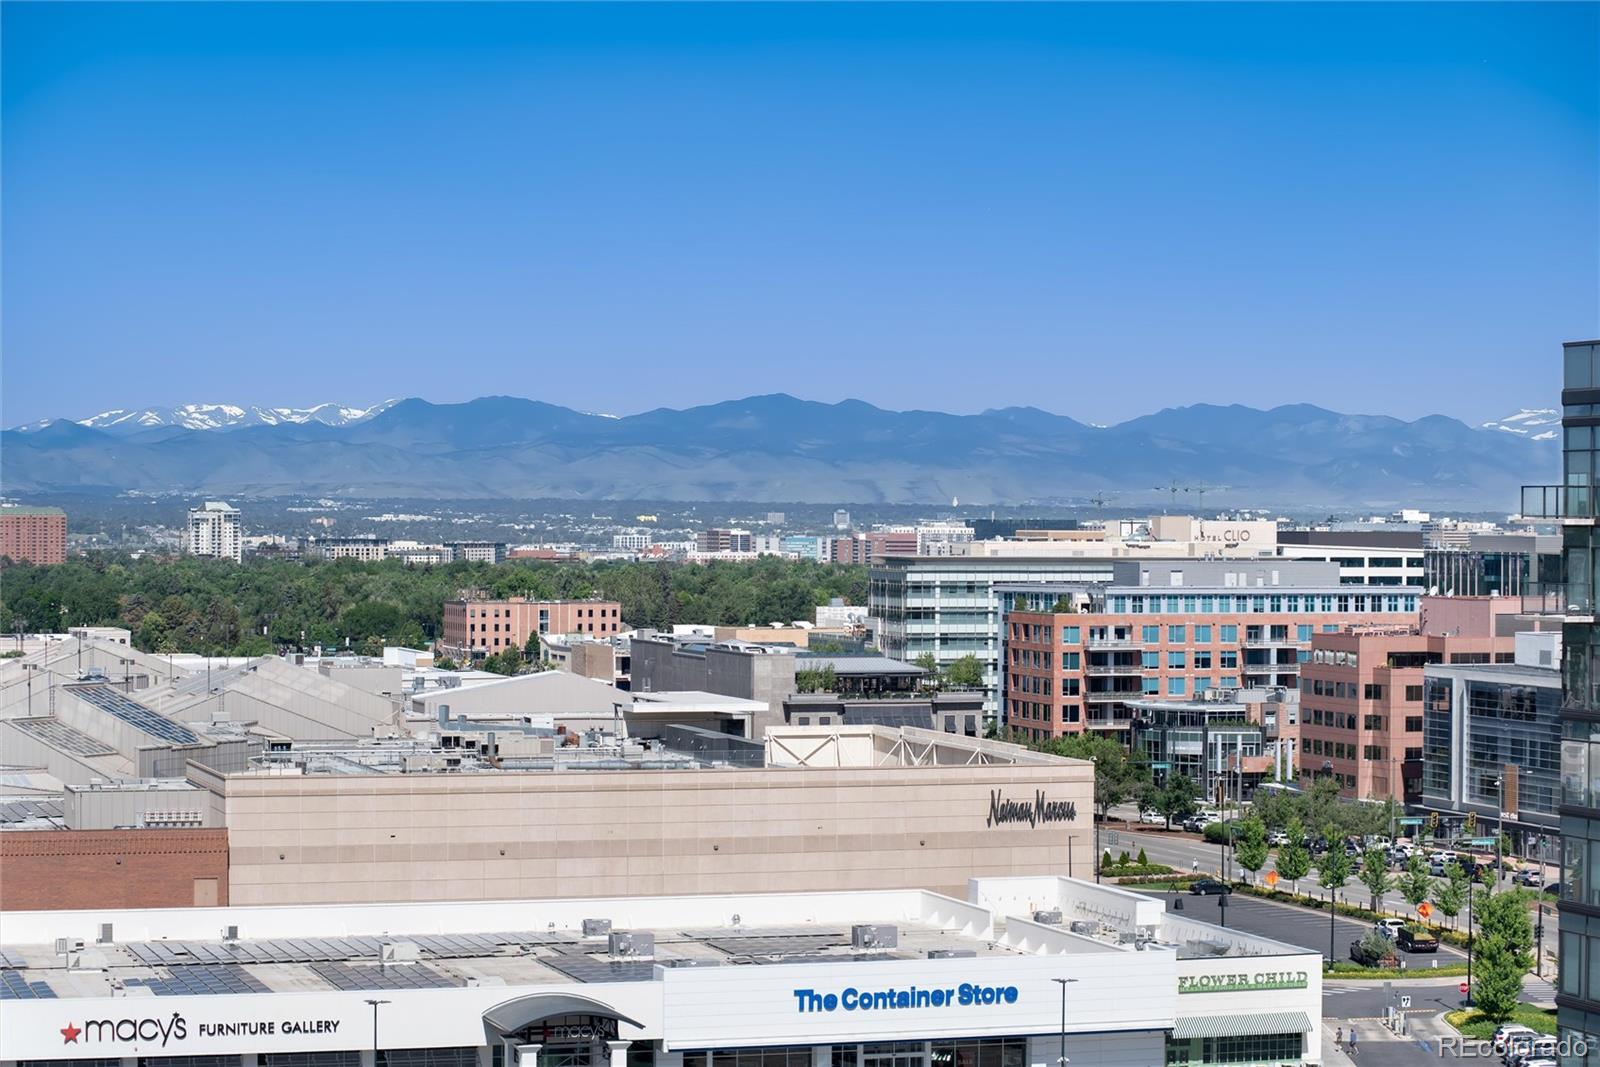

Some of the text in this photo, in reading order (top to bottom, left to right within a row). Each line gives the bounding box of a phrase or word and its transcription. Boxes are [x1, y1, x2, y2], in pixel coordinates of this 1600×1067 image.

[1223, 529, 1251, 542] CLIO
[986, 788, 1077, 829] Neiman Marcus
[1178, 971, 1309, 988] FLOWER CHILD
[793, 982, 1019, 1013] The Container Store
[85, 1012, 340, 1048] macy's FURNITURE GALLERY
